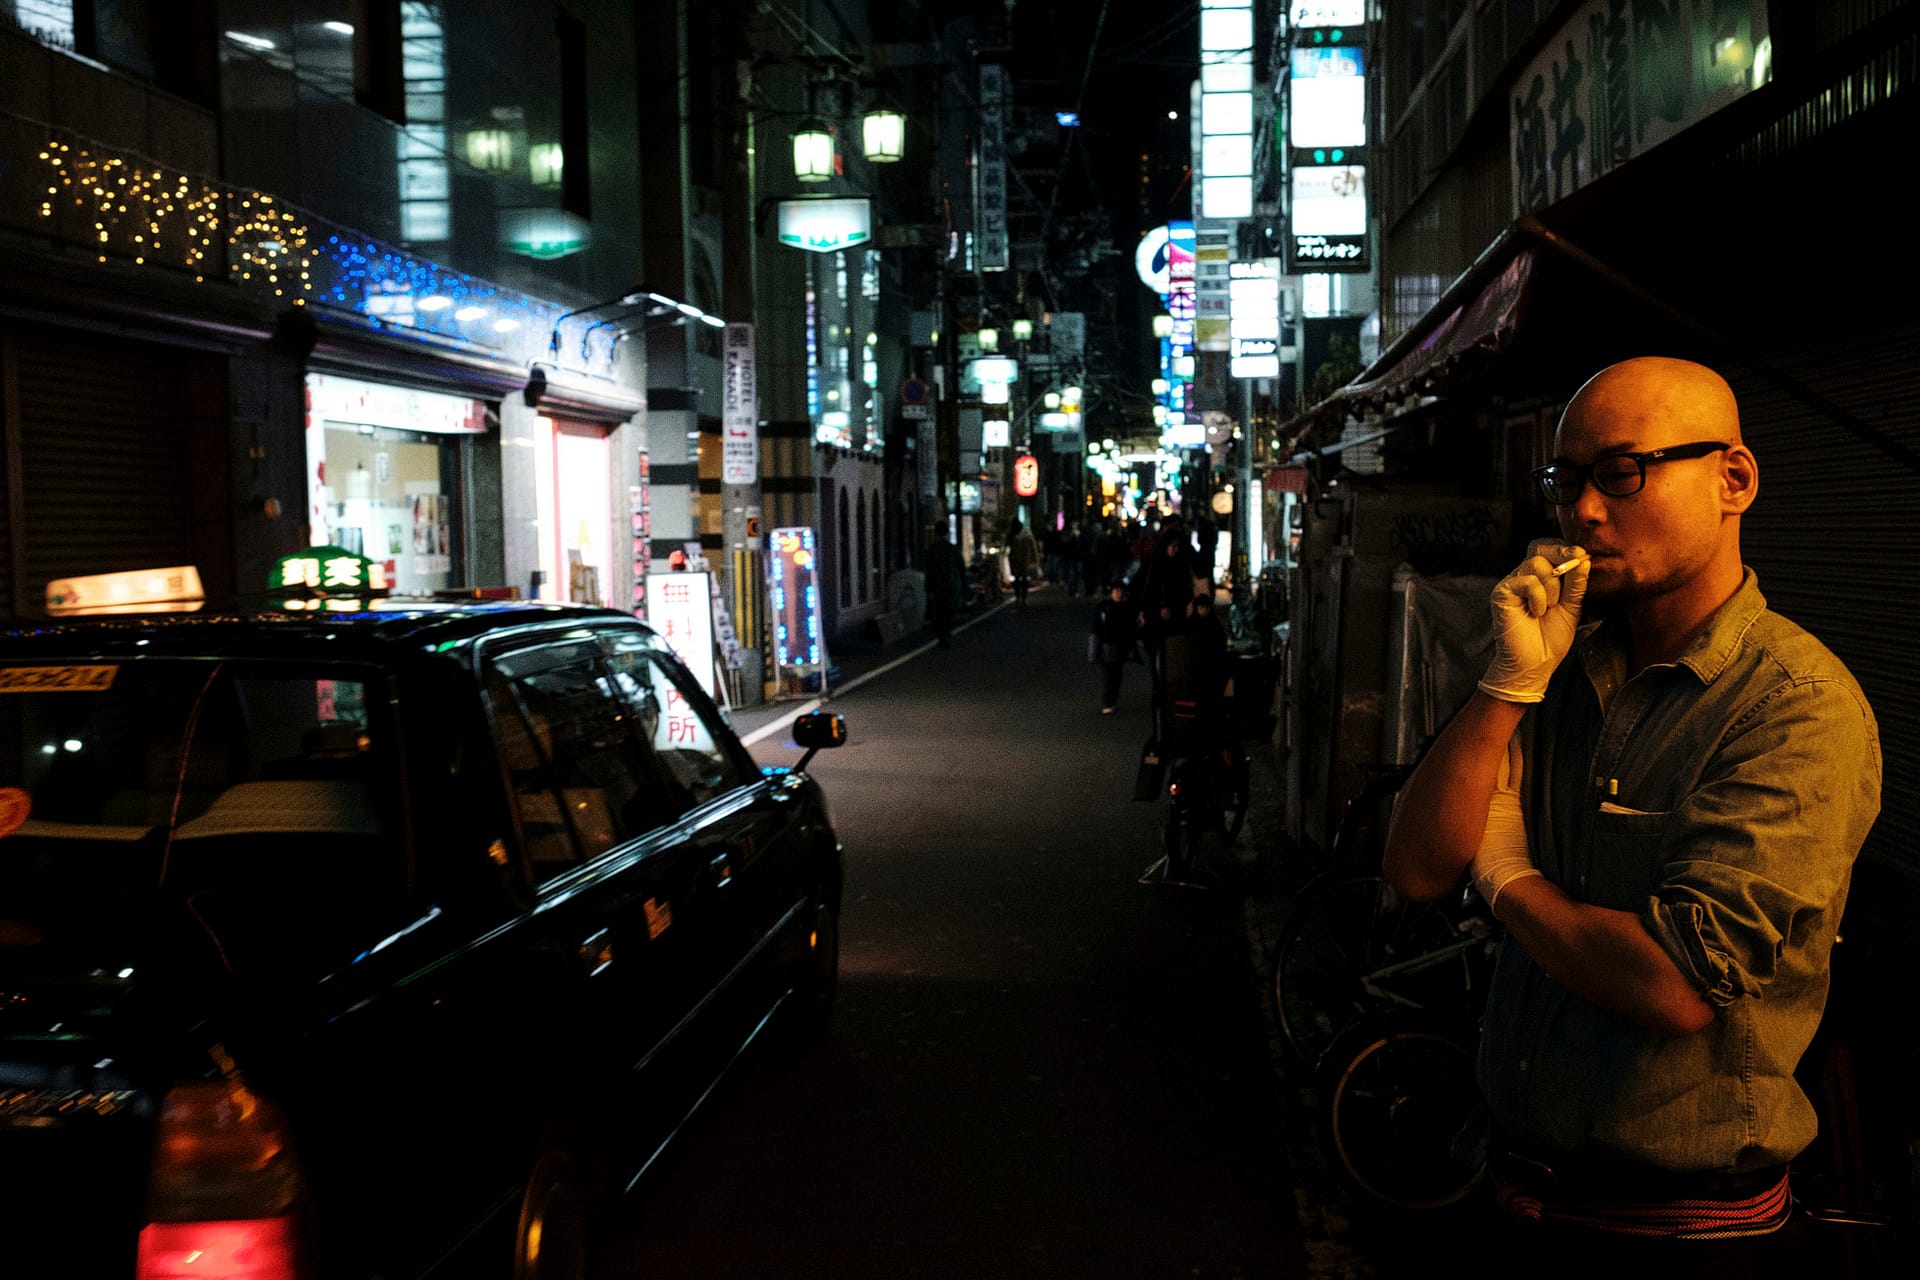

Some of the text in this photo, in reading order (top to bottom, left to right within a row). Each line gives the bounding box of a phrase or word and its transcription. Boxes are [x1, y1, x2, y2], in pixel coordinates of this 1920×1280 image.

[726, 351, 738, 413] KANADE
[740, 359, 752, 405] HOTEL
[662, 583, 698, 742] 無料内所
